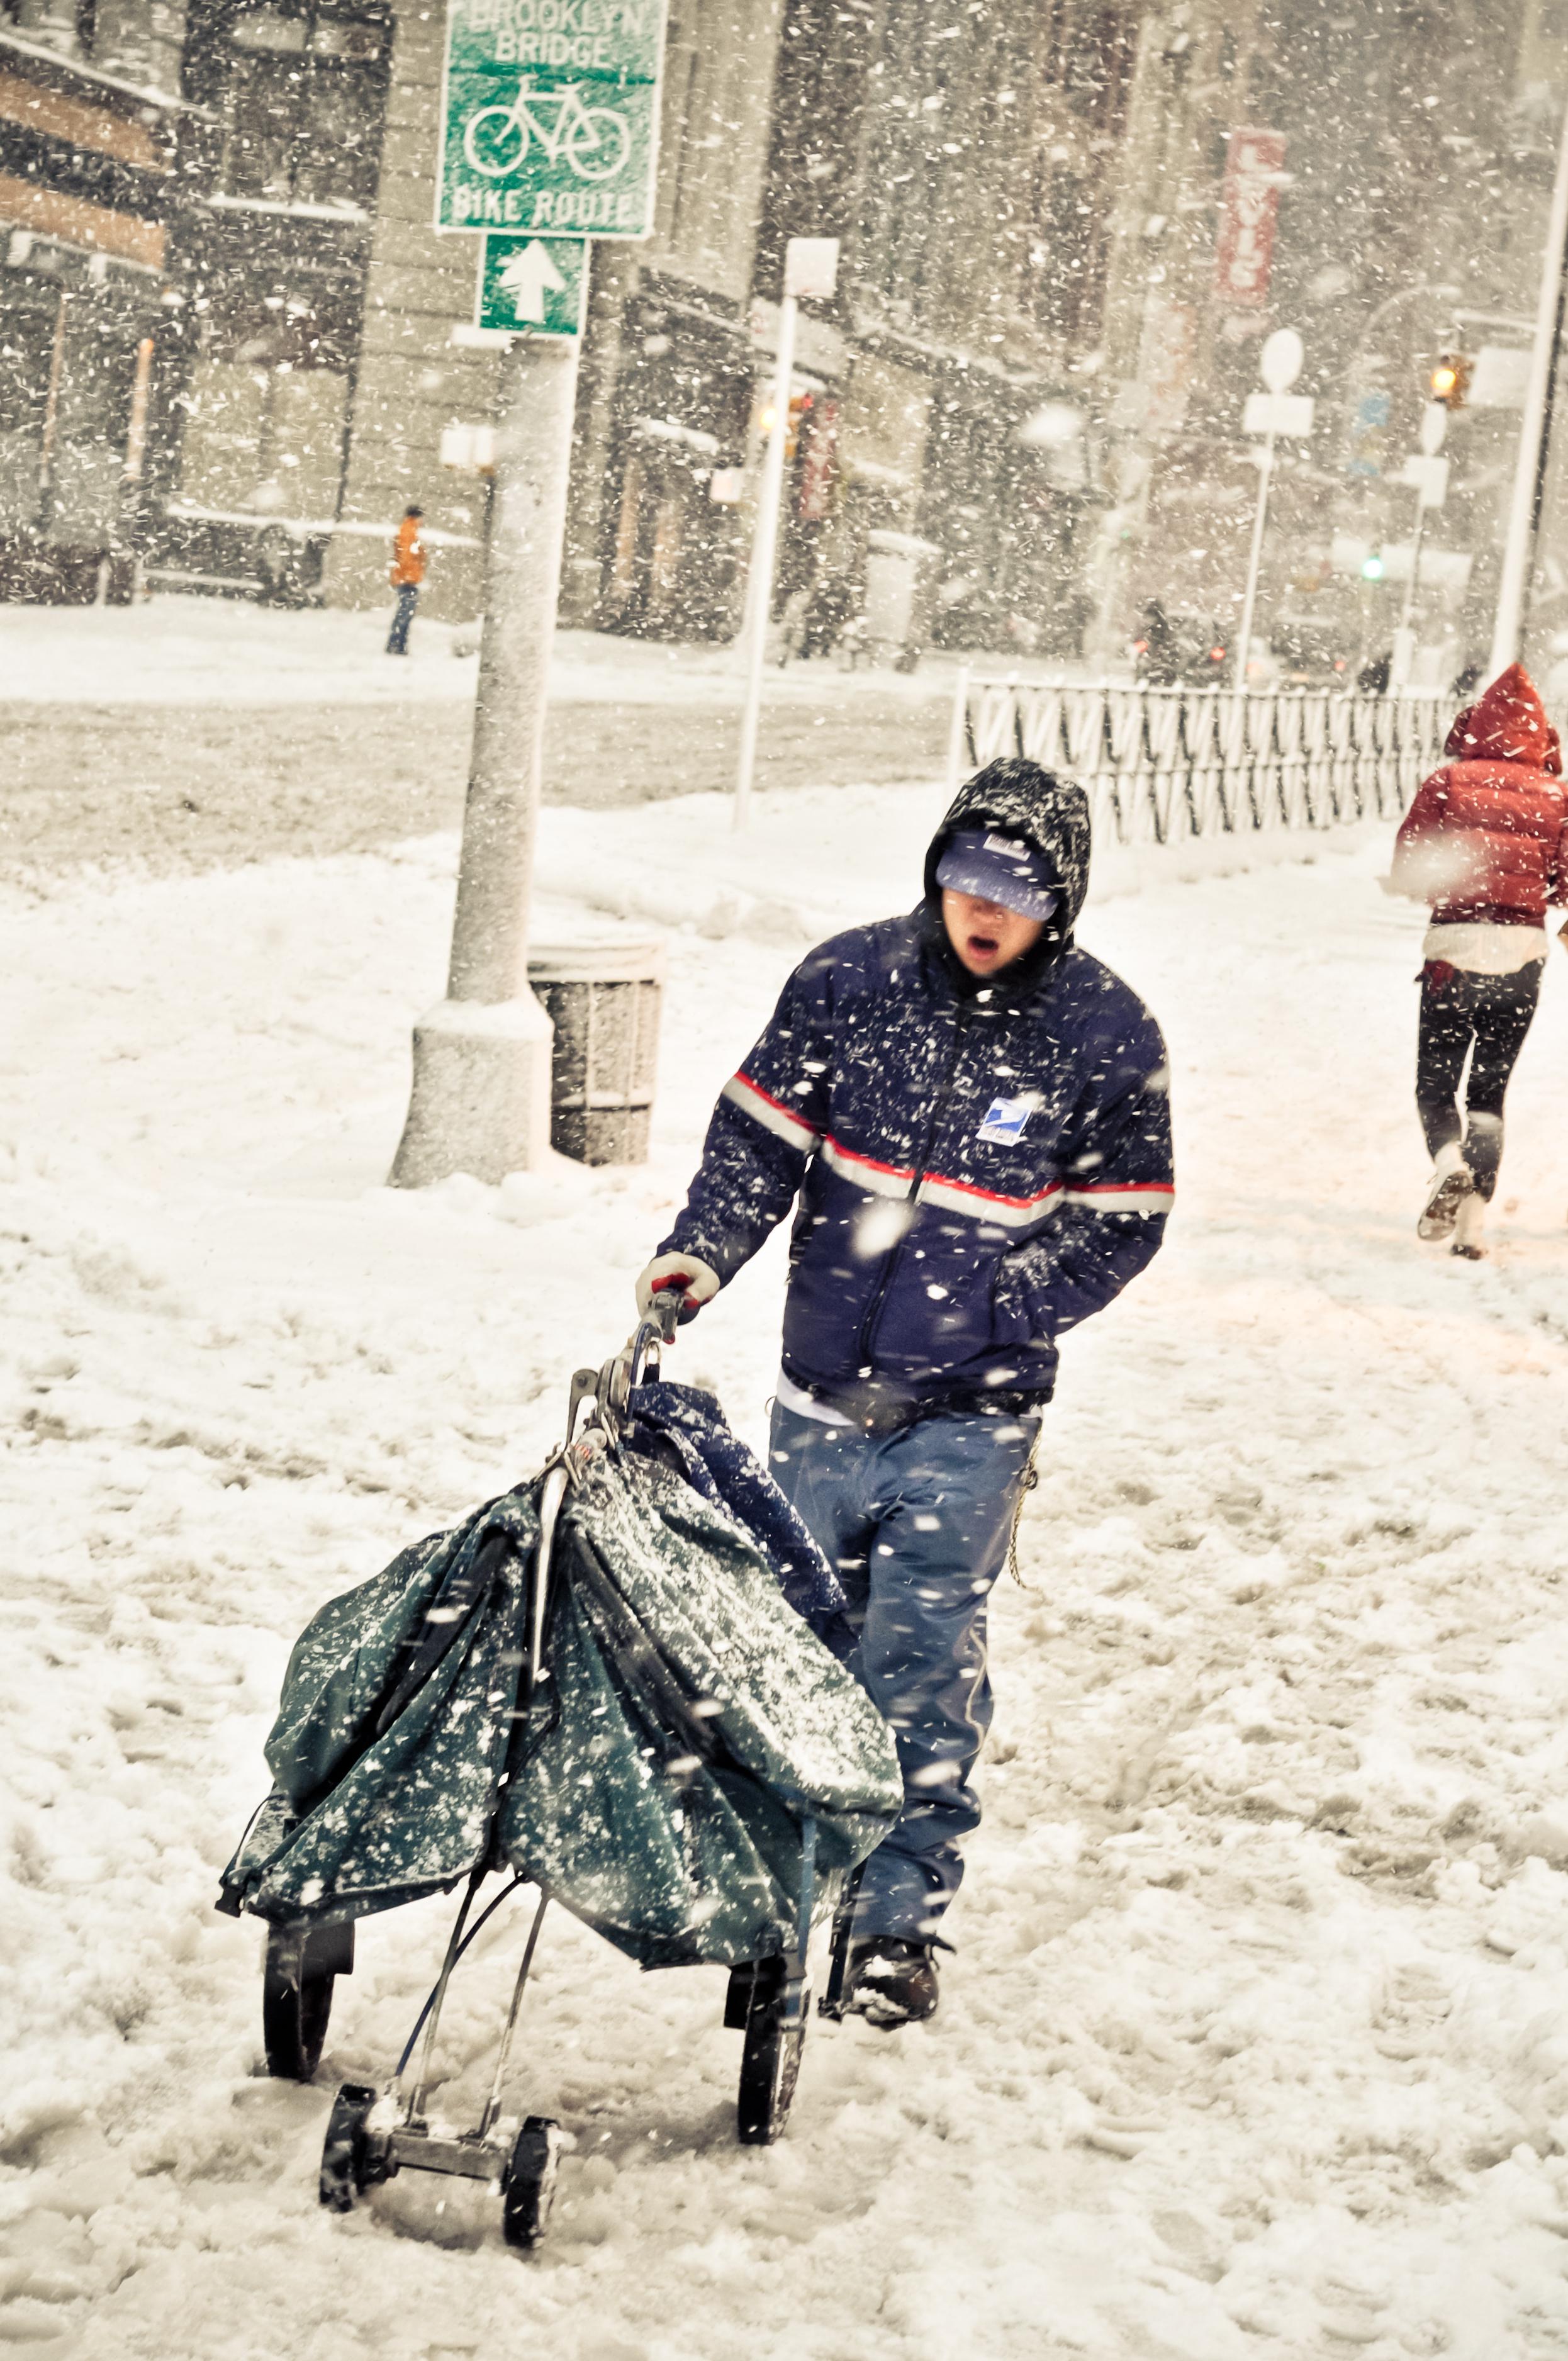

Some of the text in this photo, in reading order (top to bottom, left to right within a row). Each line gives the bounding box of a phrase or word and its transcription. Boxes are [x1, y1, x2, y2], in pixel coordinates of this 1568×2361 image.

[470, 0, 643, 34] BROOKLYN
[495, 30, 615, 69] BRIDGE
[452, 185, 633, 225] BIKE ROUTE
